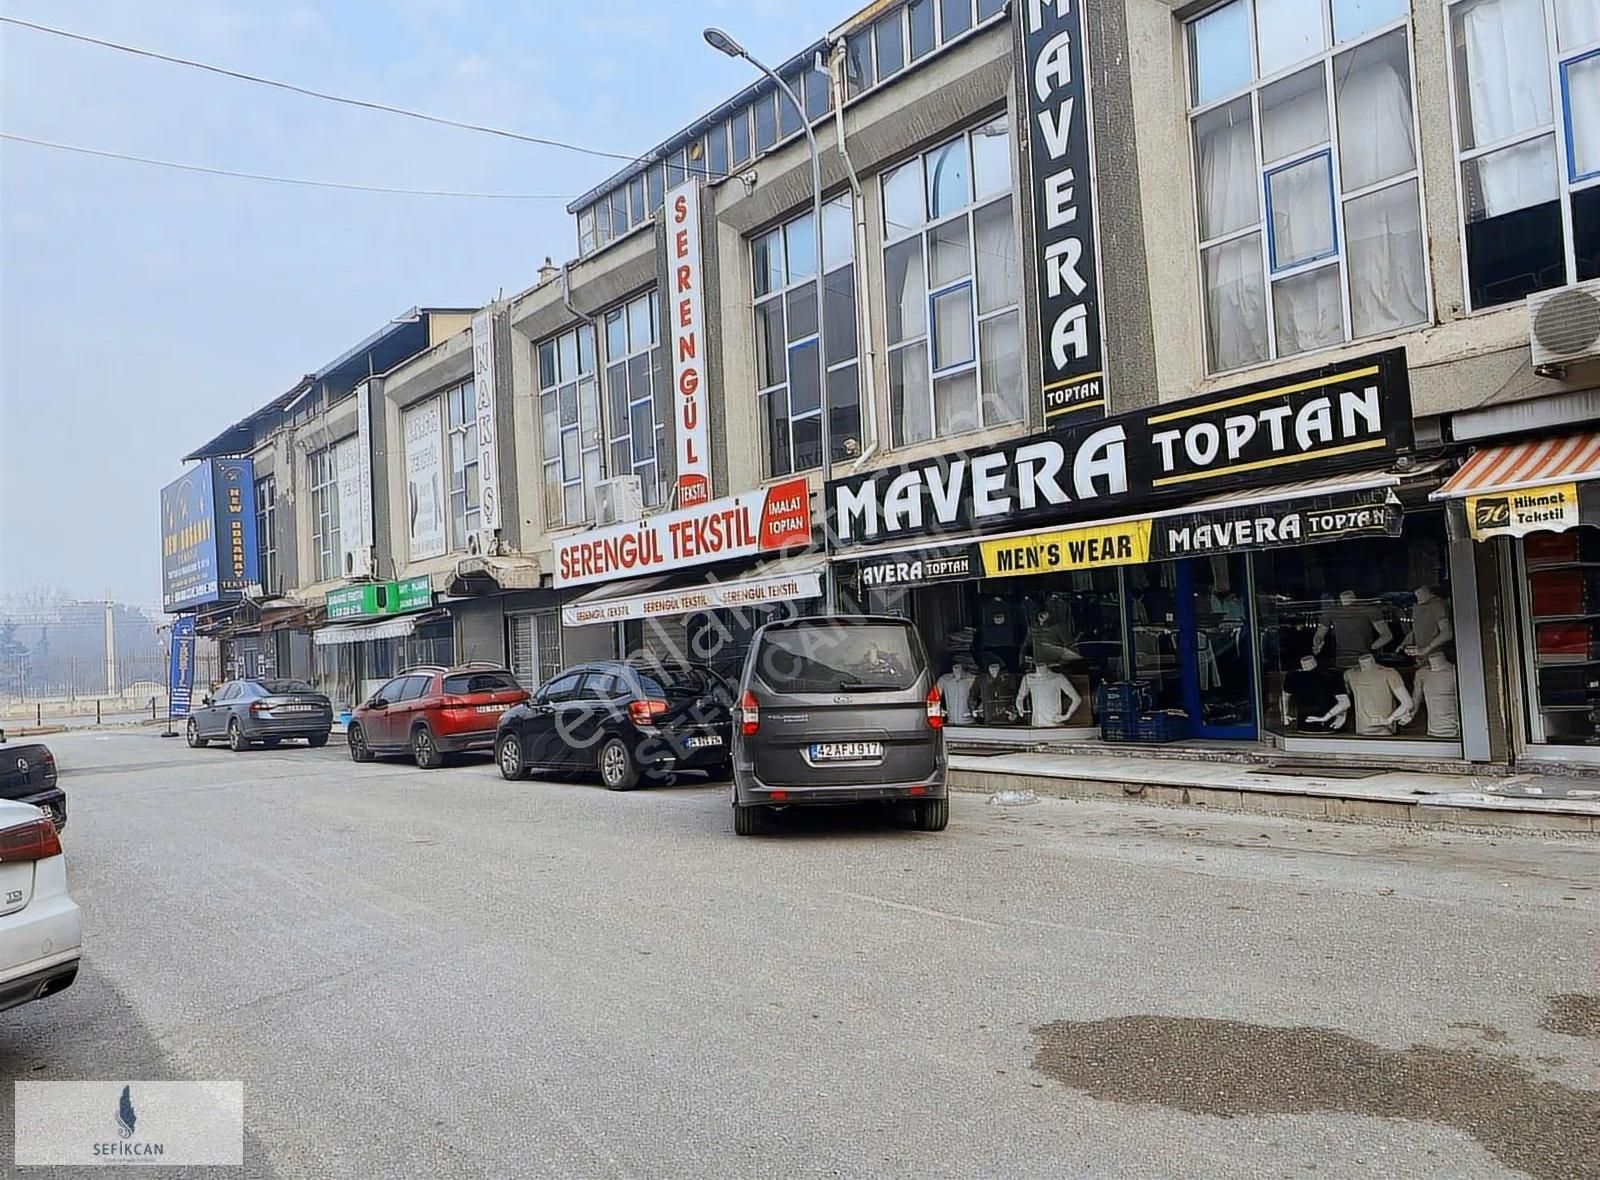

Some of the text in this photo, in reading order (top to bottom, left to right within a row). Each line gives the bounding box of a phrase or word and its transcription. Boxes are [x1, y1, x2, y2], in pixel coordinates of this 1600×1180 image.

[674, 196, 698, 464] SERENGÜL
[1047, 381, 1099, 406] TOPTAN
[835, 385, 1382, 539] MAVERA TOPTAN
[1514, 492, 1565, 508] Hikmet
[560, 499, 756, 580] SERENGÜL TEKSTİL
[768, 516, 803, 536] TOPTAN
[1168, 508, 1384, 552] MAVERA TOPTAN
[863, 559, 969, 585] AVERA TOPTAN
[997, 535, 1132, 572] MEN'S WEAR
